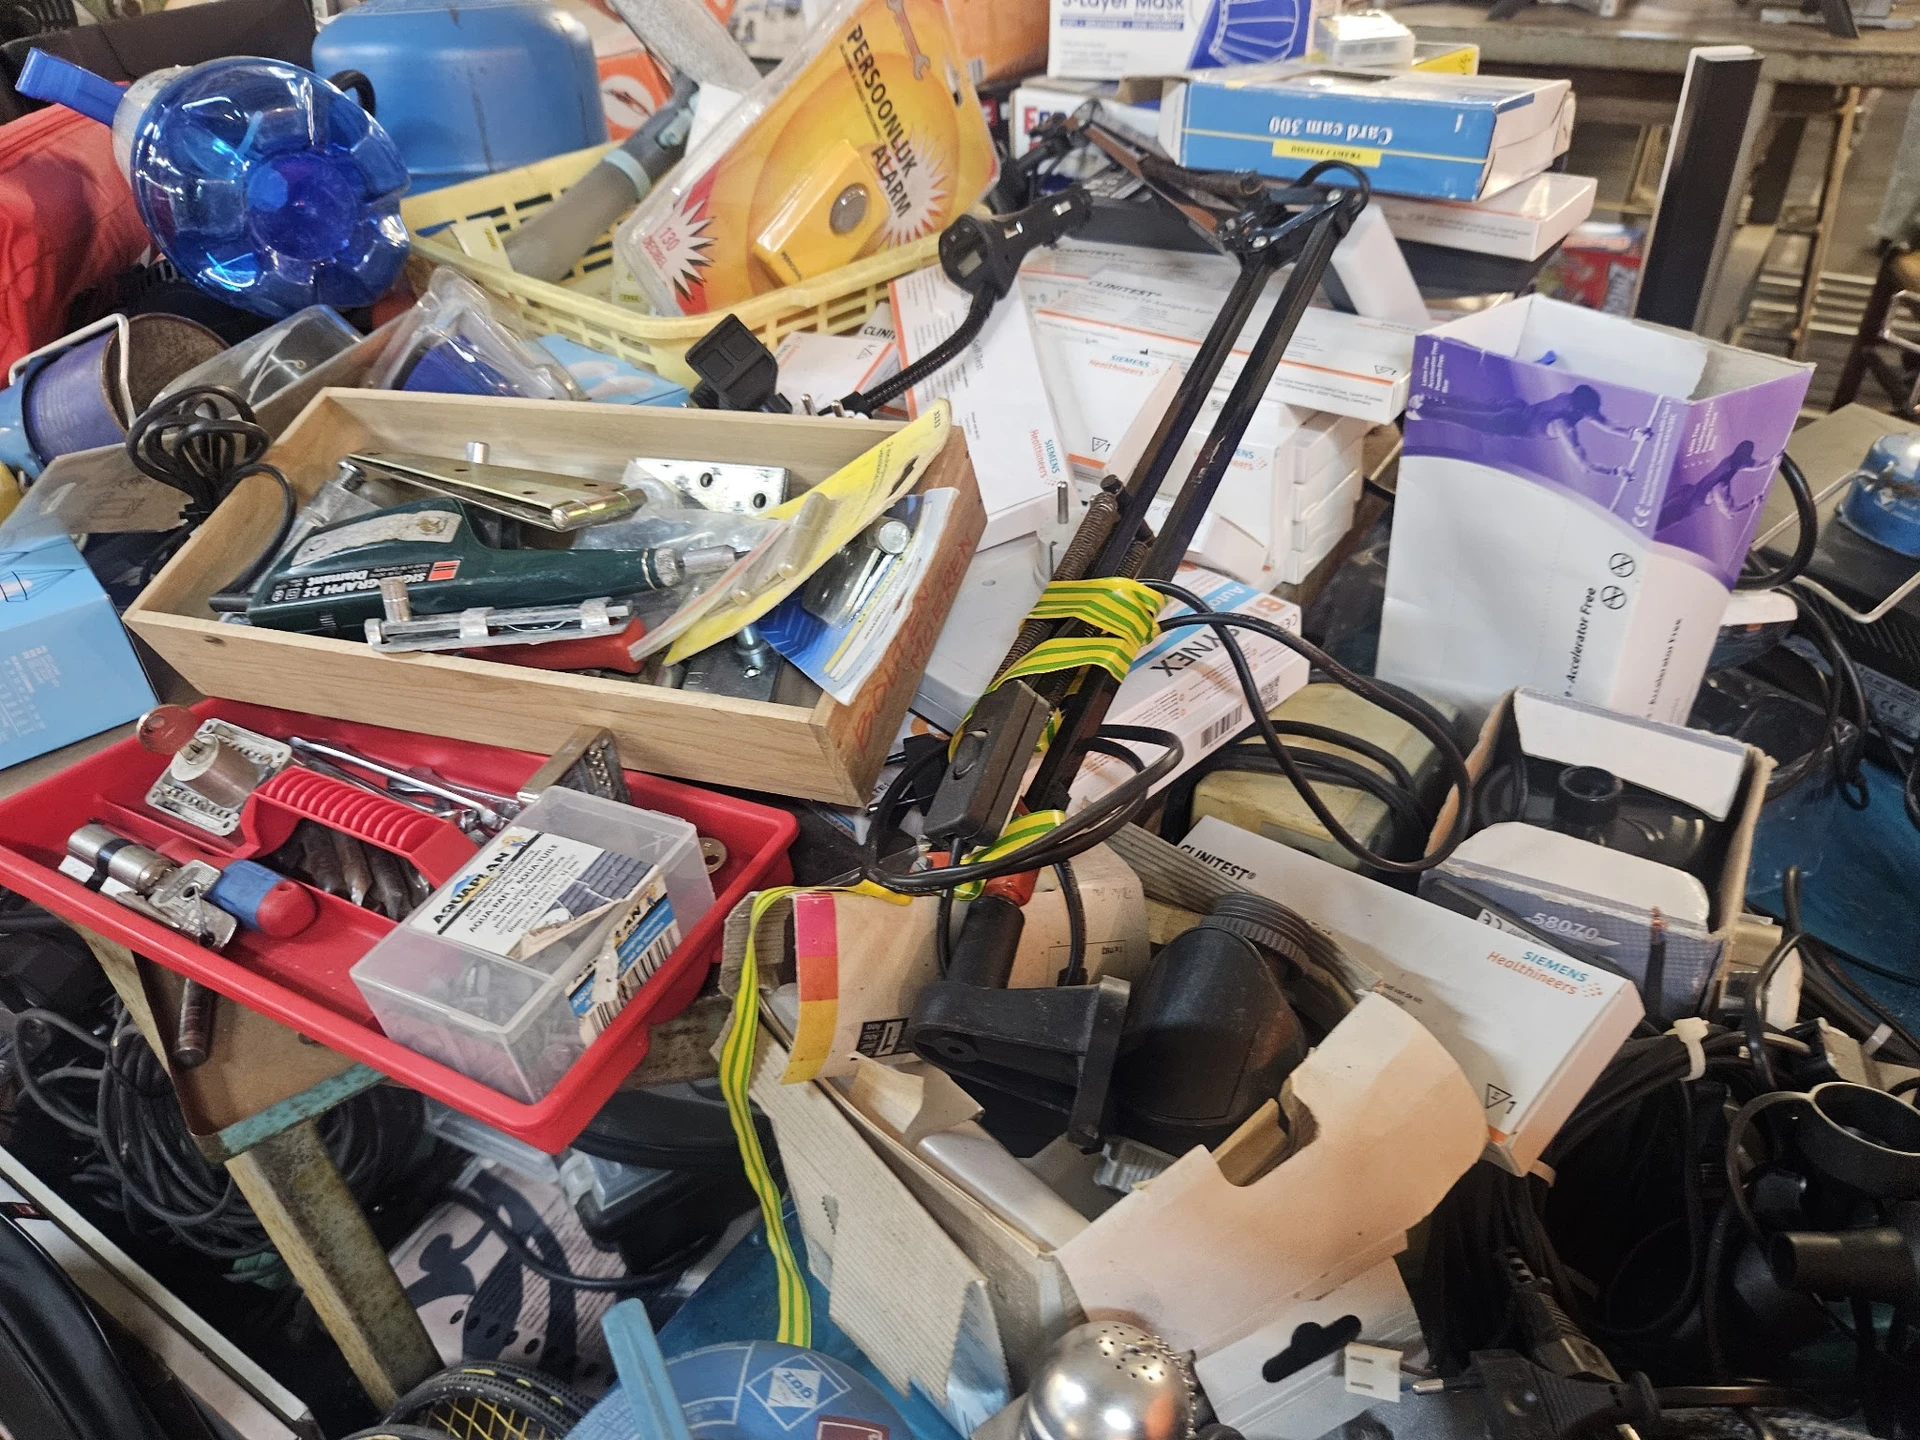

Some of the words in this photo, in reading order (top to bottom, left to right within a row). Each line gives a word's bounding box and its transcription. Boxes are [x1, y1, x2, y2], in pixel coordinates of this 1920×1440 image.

[847, 24, 918, 178] PERSOONLIJK
[1268, 115, 1303, 137] 300
[1305, 119, 1344, 137] cam
[1346, 124, 1393, 146] Card
[871, 145, 912, 218] ALARM
[659, 227, 681, 251] 130
[1111, 354, 1151, 368] SIEMENS
[1030, 429, 1049, 479] Healthineers
[1045, 439, 1061, 474] SIEMENS
[306, 569, 369, 586] Diamant
[1566, 617, 1589, 684] Accelerator
[1580, 587, 1597, 615] Free
[433, 852, 510, 925] AQUAPLAN
[1531, 912, 1600, 941] 58070
[1486, 951, 1578, 995] Healthineers
[1522, 951, 1589, 982] SIEMENS
[1507, 1099, 1517, 1115] 1
